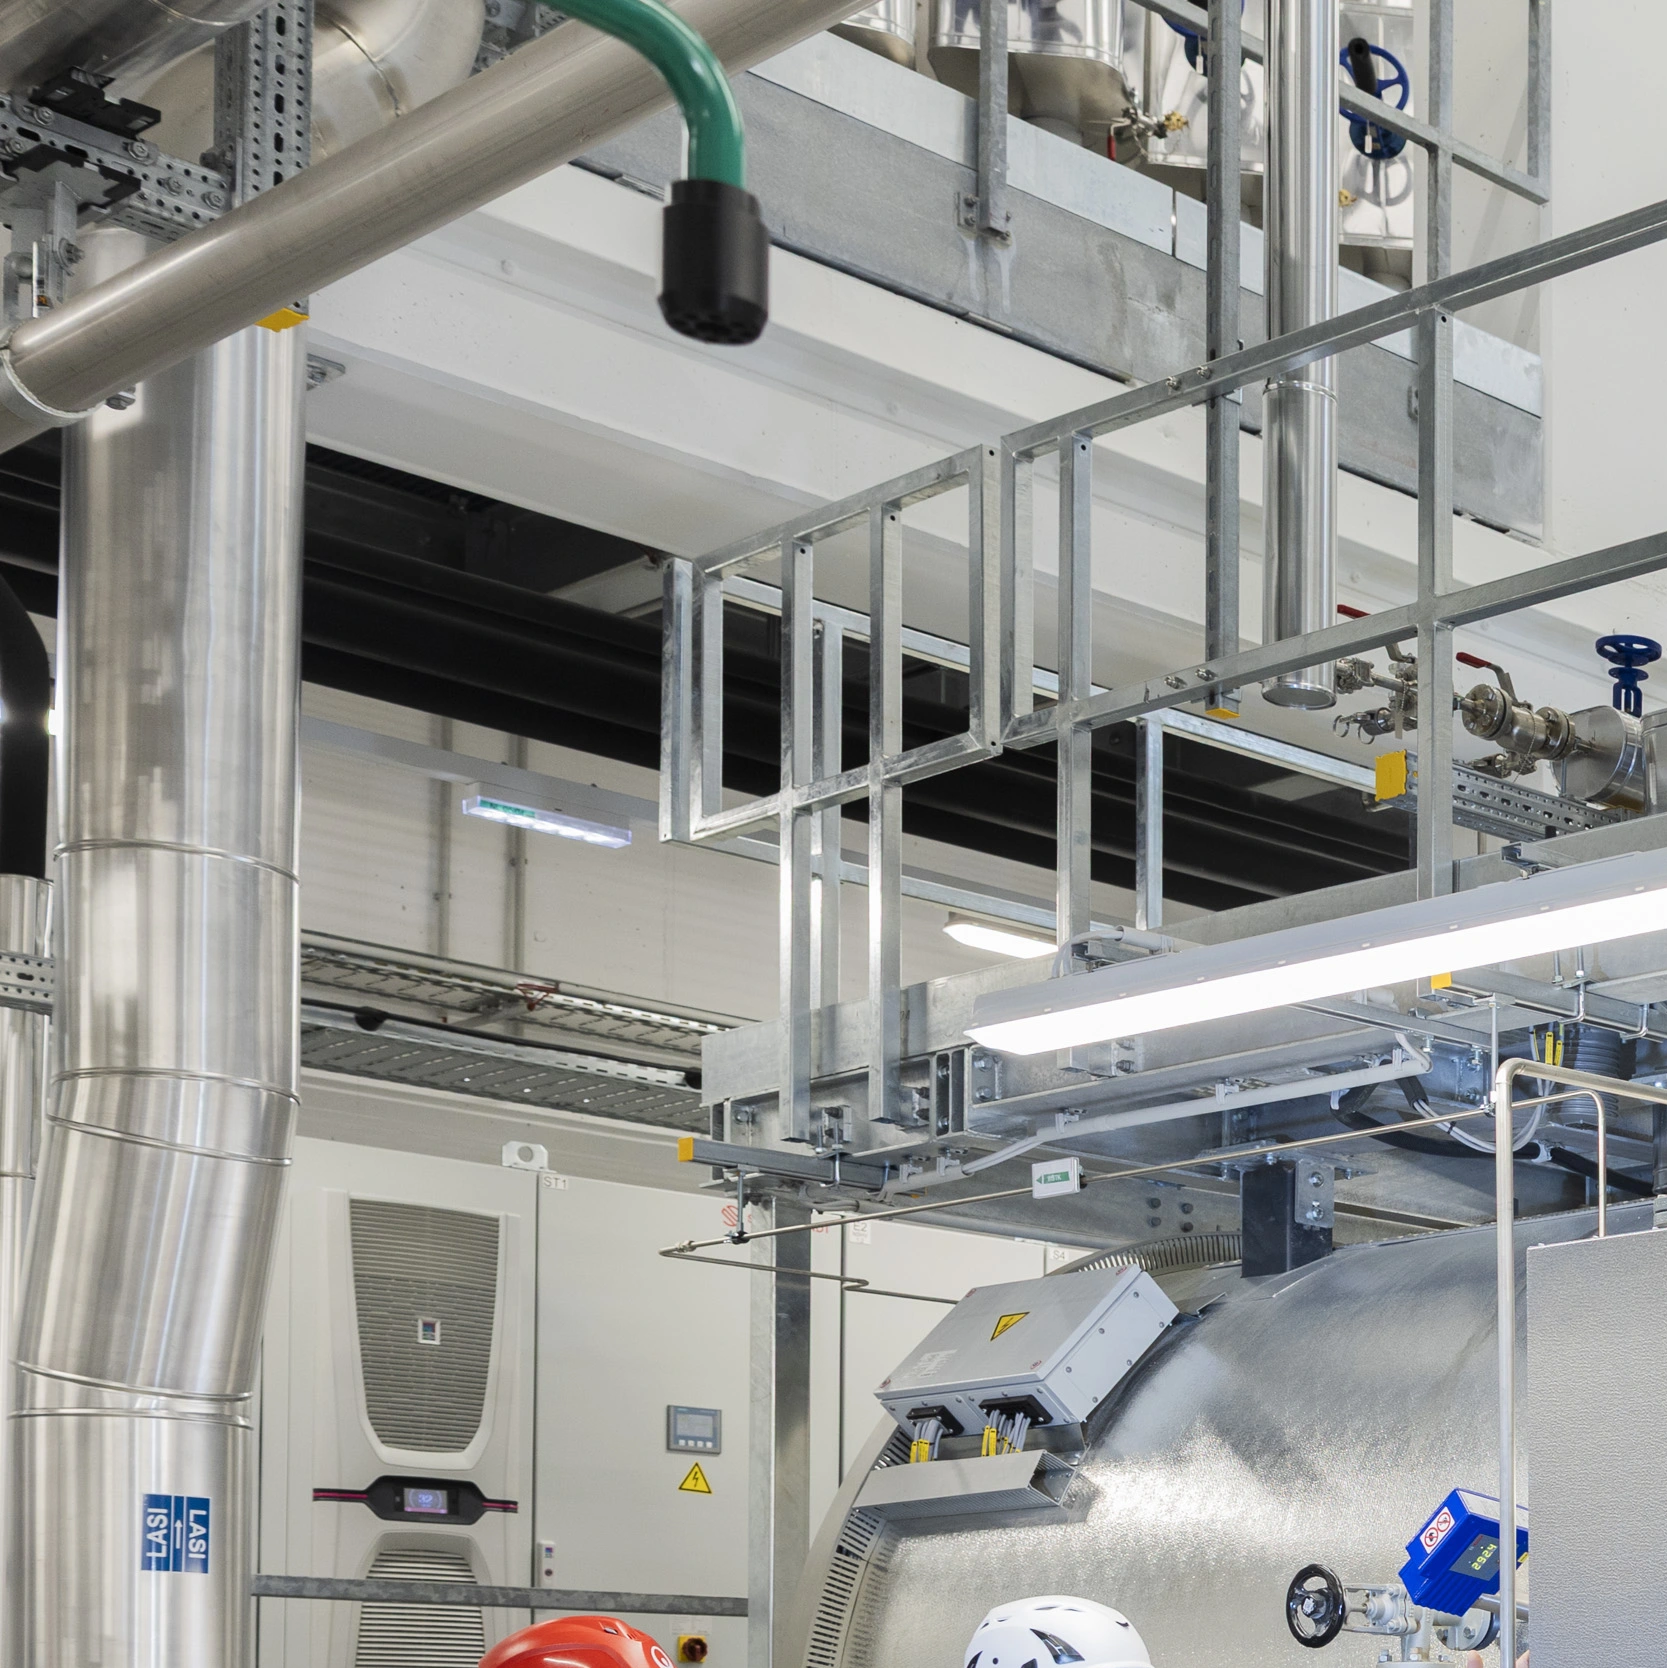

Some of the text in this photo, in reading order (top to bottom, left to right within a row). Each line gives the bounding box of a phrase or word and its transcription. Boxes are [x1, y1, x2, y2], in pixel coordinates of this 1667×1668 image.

[544, 1176, 567, 1189] ST1
[146, 1508, 168, 1557] LASI
[188, 1509, 207, 1559] LASI
